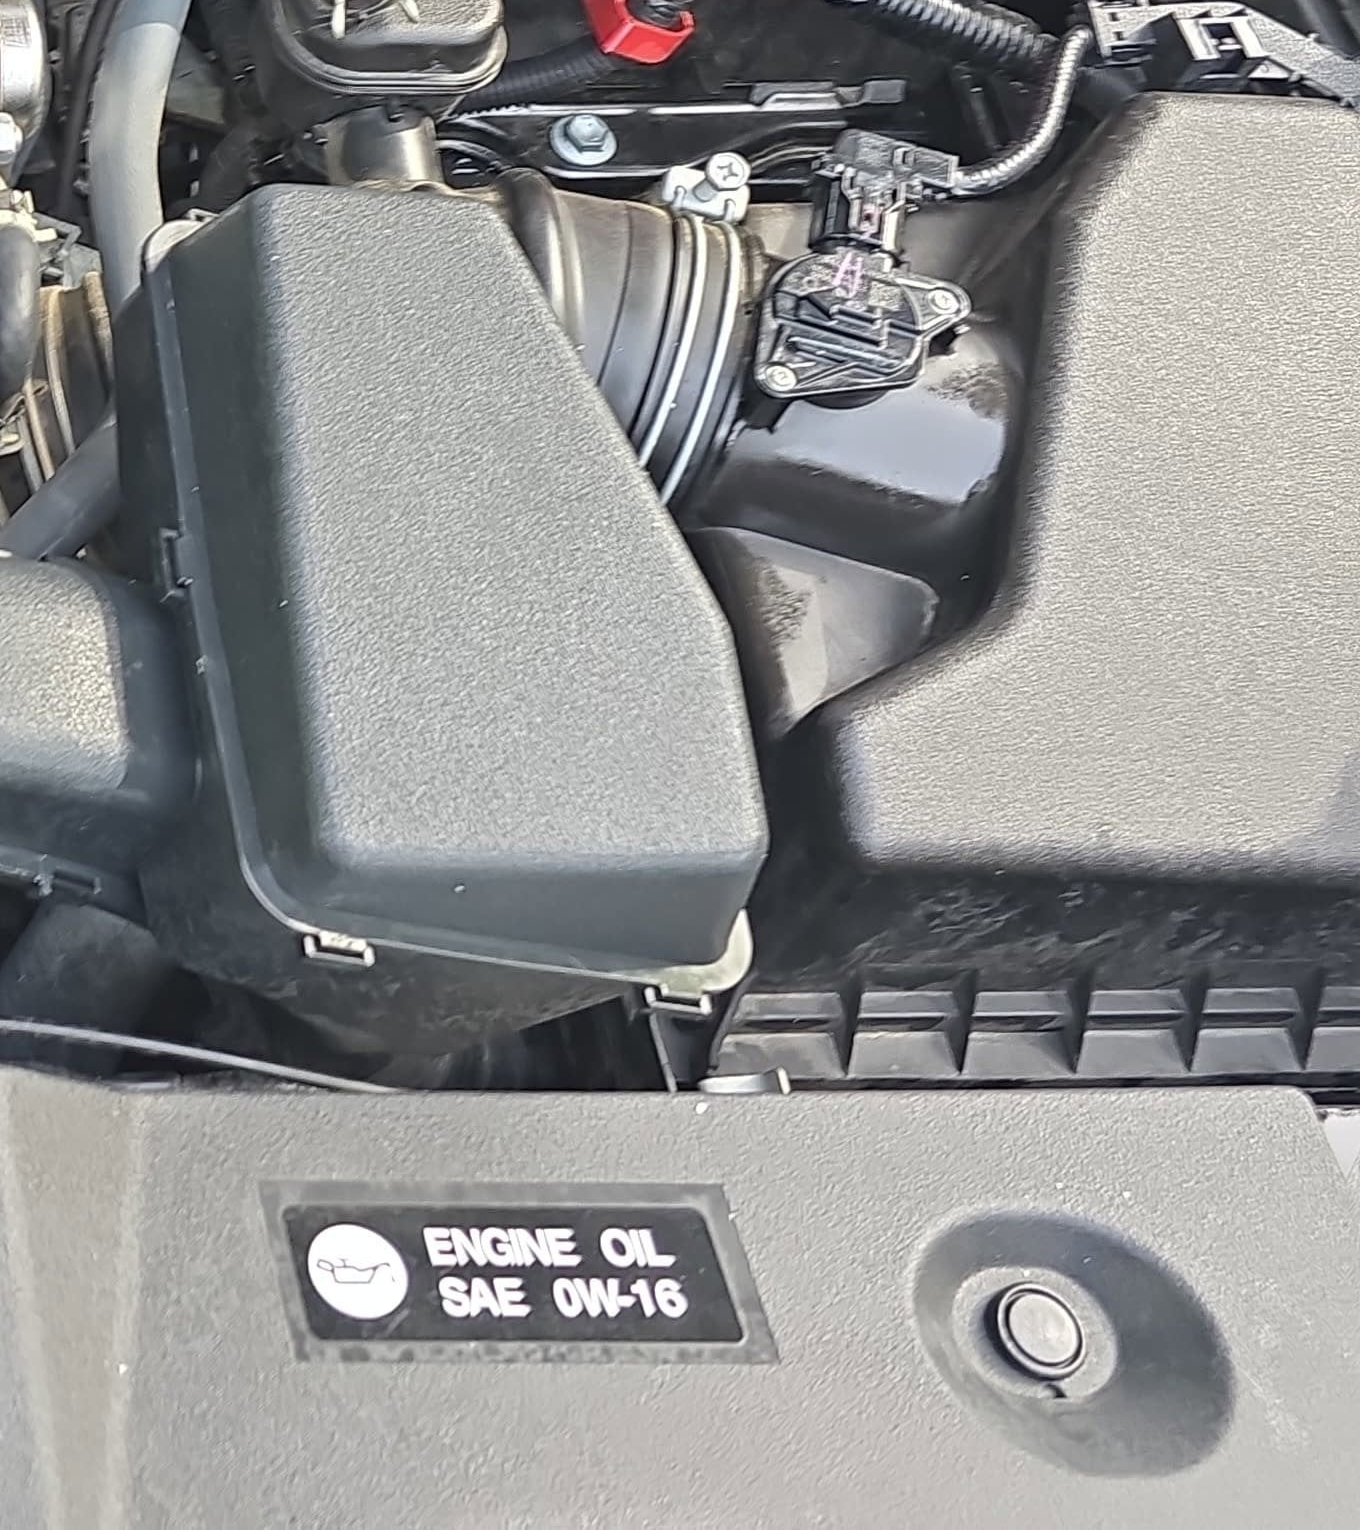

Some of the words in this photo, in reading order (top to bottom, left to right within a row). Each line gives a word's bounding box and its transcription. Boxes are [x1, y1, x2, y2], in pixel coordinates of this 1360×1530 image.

[423, 1227, 581, 1268] ENGINE
[599, 1228, 676, 1268] OIL
[438, 1276, 532, 1319] SAE
[550, 1277, 689, 1320] 0W-16
